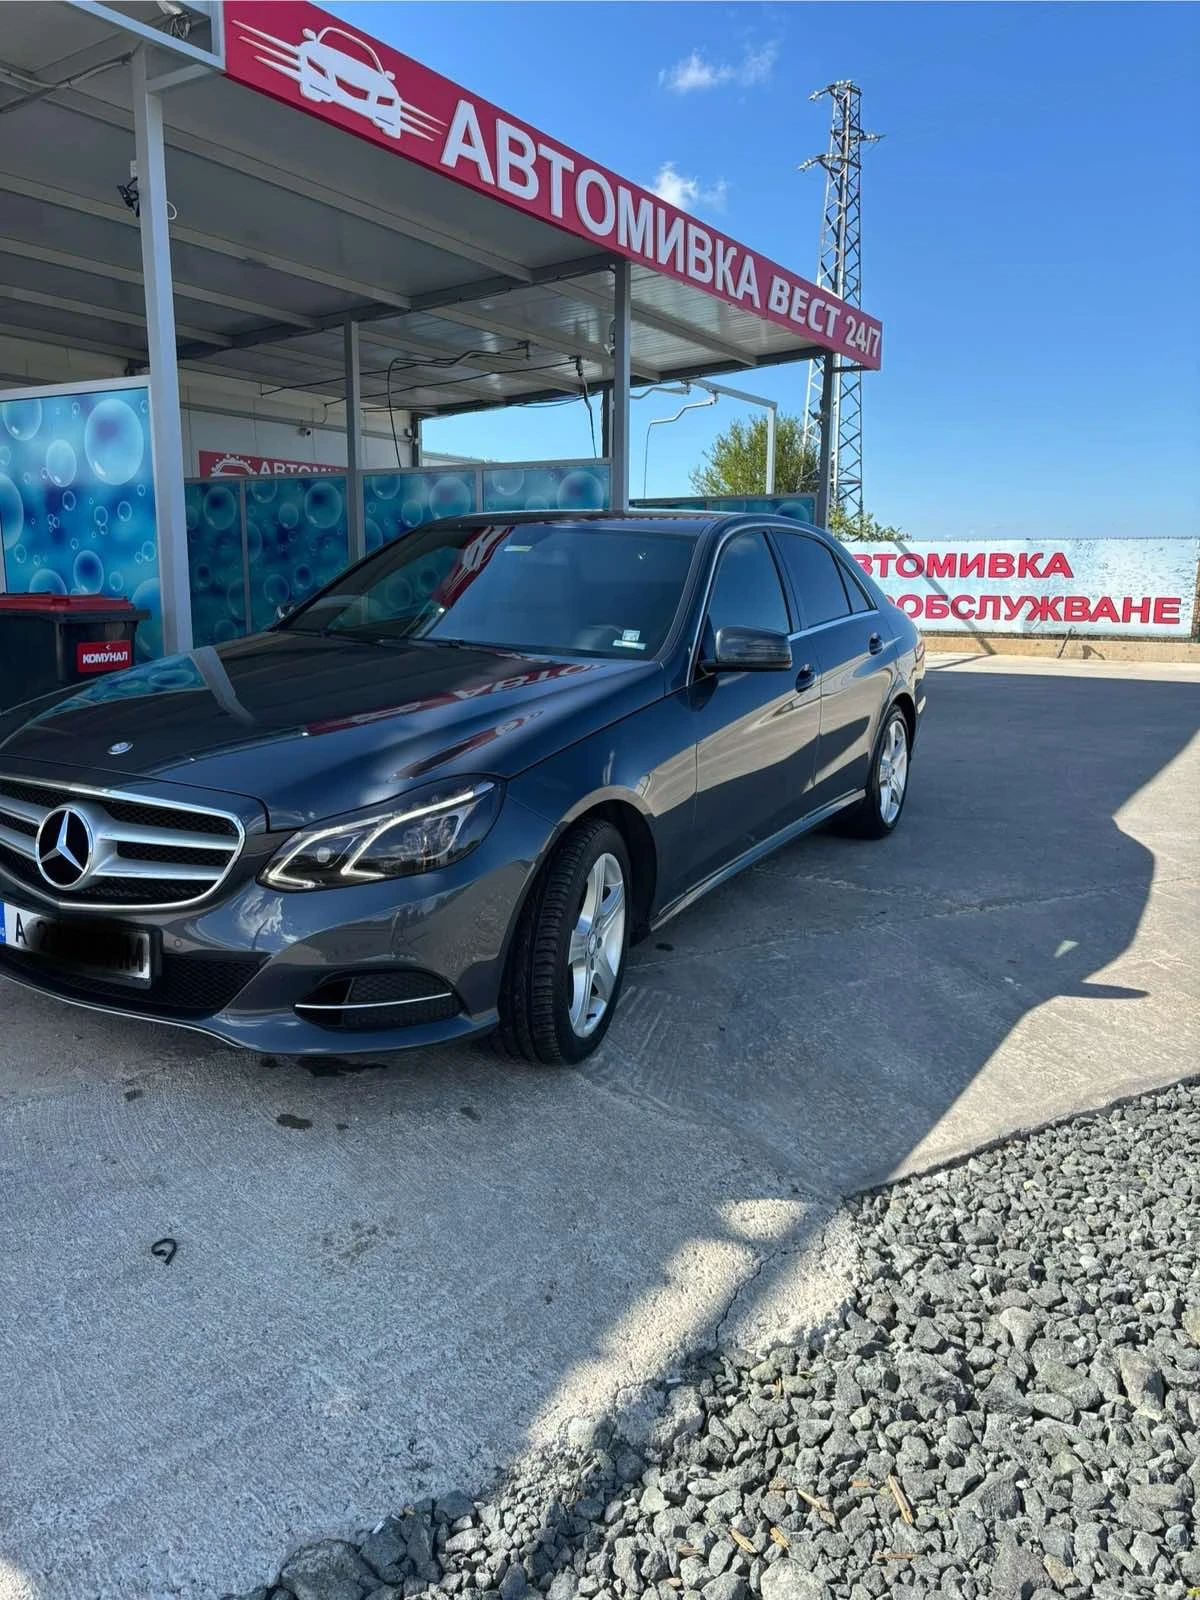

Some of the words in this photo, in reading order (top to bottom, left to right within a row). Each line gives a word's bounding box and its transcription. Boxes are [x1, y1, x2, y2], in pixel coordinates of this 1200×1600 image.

[440, 99, 761, 309] АВТОМИВКА
[768, 275, 841, 338] ВЕСТ
[845, 315, 881, 358] 24/7
[886, 594, 1182, 624] ОБСЛУЖВАНЕ
[83, 651, 128, 664] КОМУНАЛ
